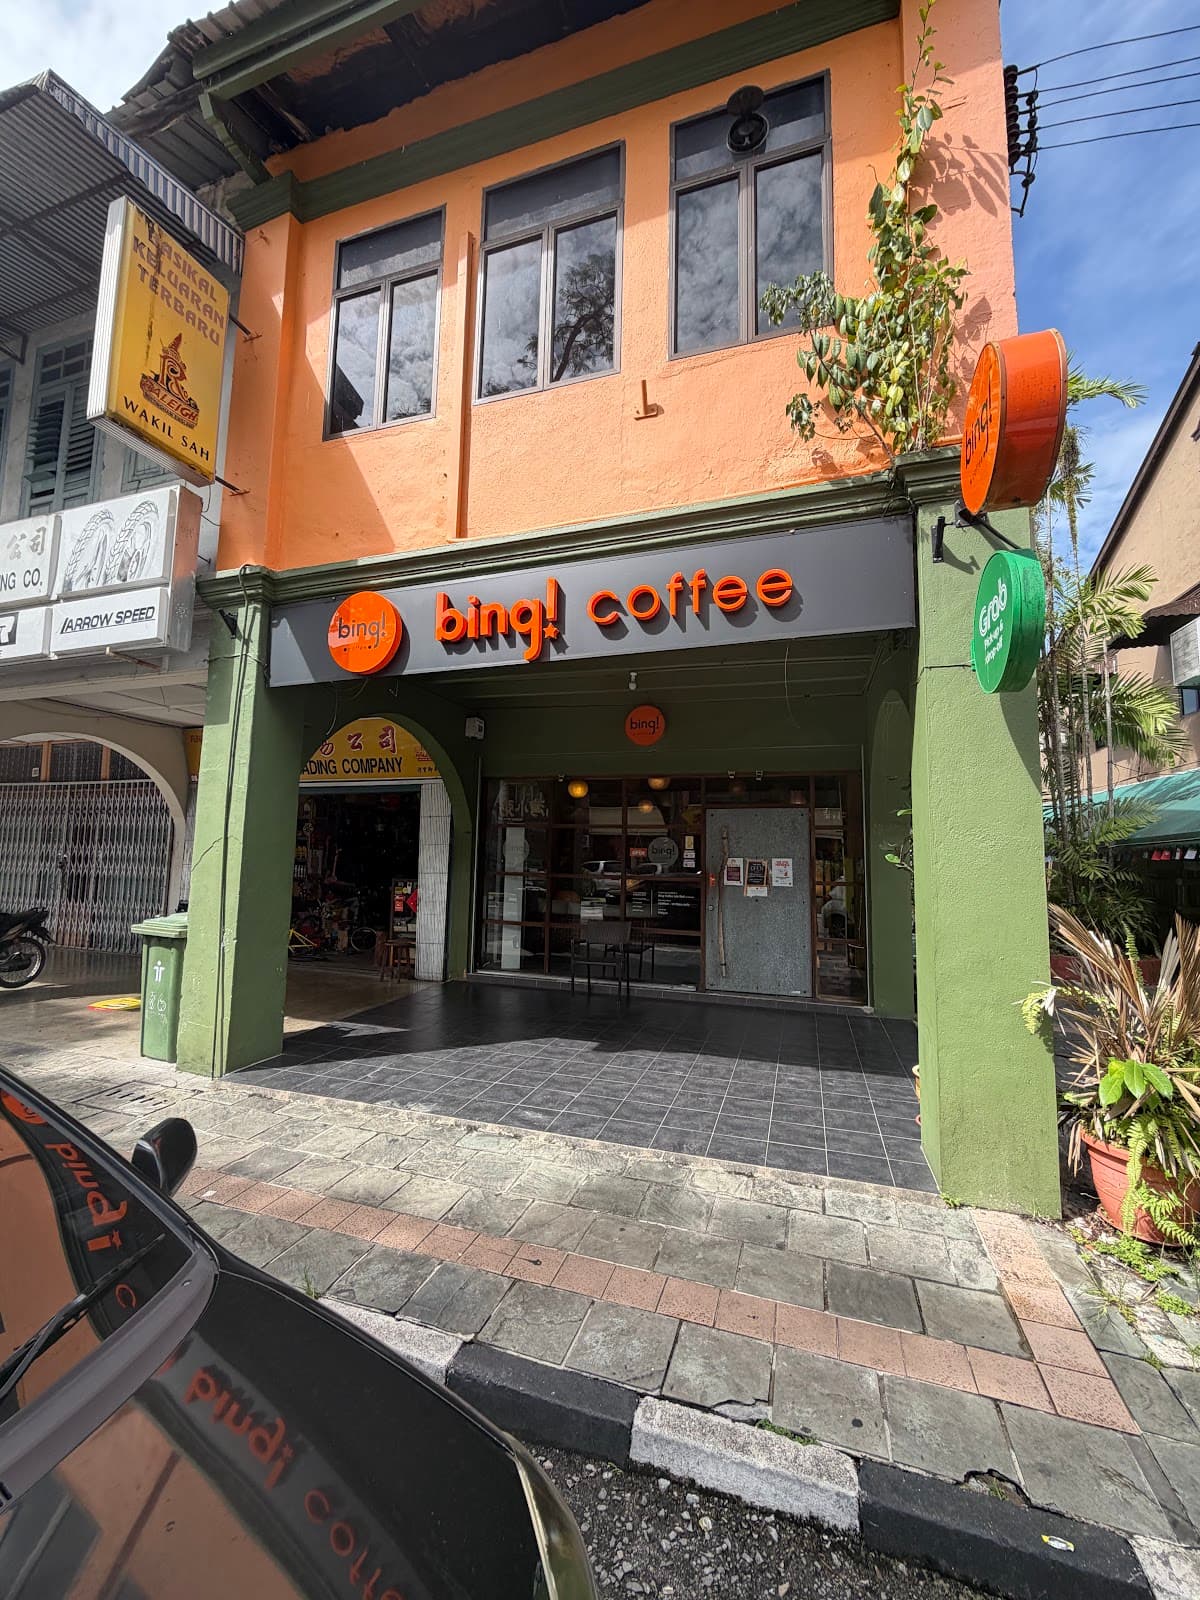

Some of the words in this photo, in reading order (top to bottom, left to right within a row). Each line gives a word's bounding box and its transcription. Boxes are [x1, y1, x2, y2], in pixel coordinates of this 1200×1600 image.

[133, 235, 225, 329] KELUARAN
[137, 263, 220, 346] TERBARU
[123, 396, 174, 440] WAKIL
[181, 435, 209, 461] SAH
[965, 376, 992, 470] bing!
[23, 568, 43, 588] CO.
[979, 577, 1007, 637] Grab
[60, 612, 113, 634] ARROW
[115, 606, 155, 624] SPEED
[338, 610, 386, 649] bing!
[435, 577, 560, 663] bing!
[586, 568, 793, 626] coffee
[630, 716, 659, 735] bing!
[342, 756, 402, 774] COMPANY
